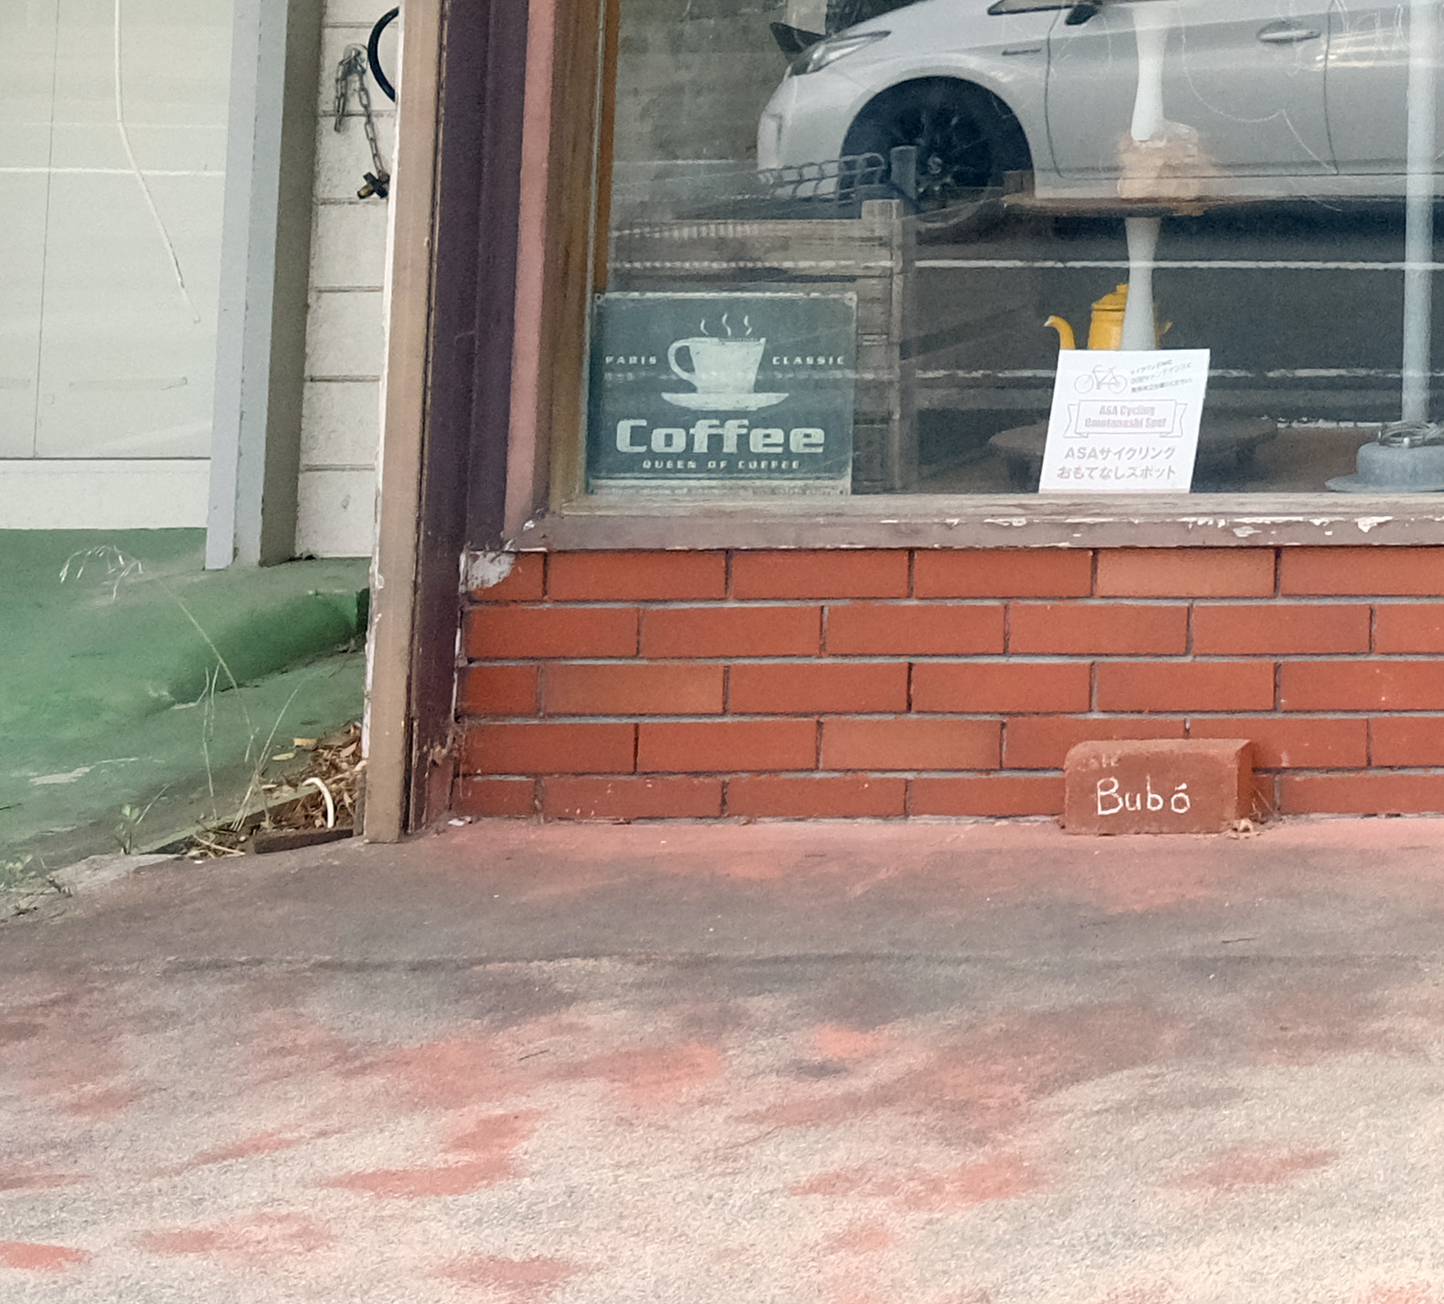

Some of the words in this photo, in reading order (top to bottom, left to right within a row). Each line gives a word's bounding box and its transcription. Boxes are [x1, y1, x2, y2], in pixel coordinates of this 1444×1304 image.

[772, 355, 846, 366] CLASSIC
[615, 418, 826, 455] Coffee
[1064, 446, 1177, 461] ASAサイクリング
[1096, 774, 1192, 816] Bubó
